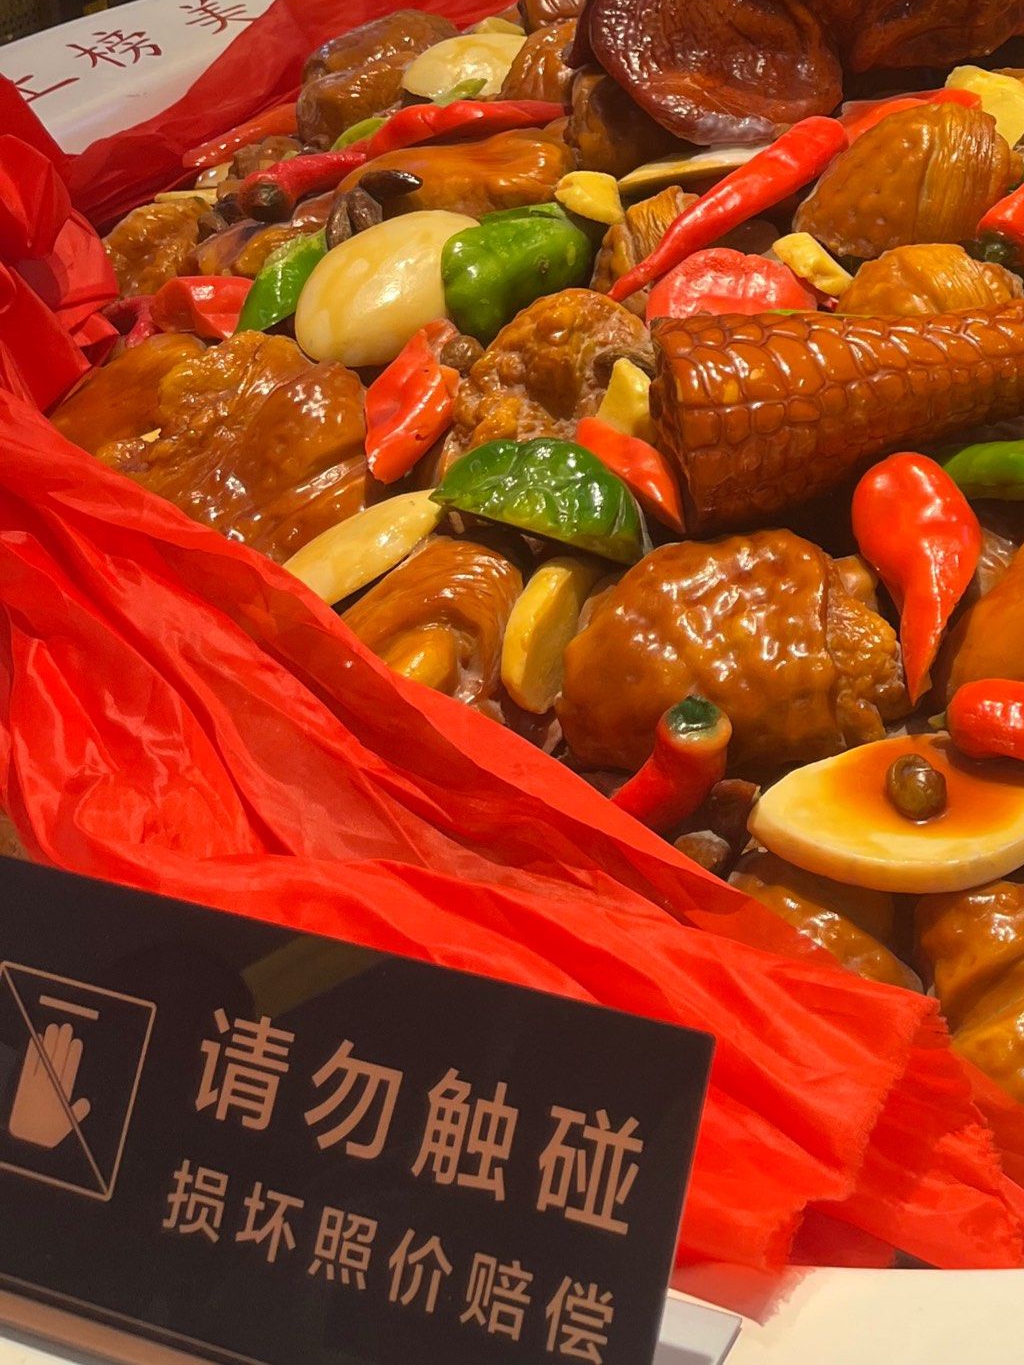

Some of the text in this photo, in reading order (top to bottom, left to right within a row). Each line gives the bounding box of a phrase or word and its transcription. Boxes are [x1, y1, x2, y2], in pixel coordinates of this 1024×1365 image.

[195, 1008, 643, 1235] 请勿触碰
[162, 1159, 614, 1365] 损坏照价赔偿
